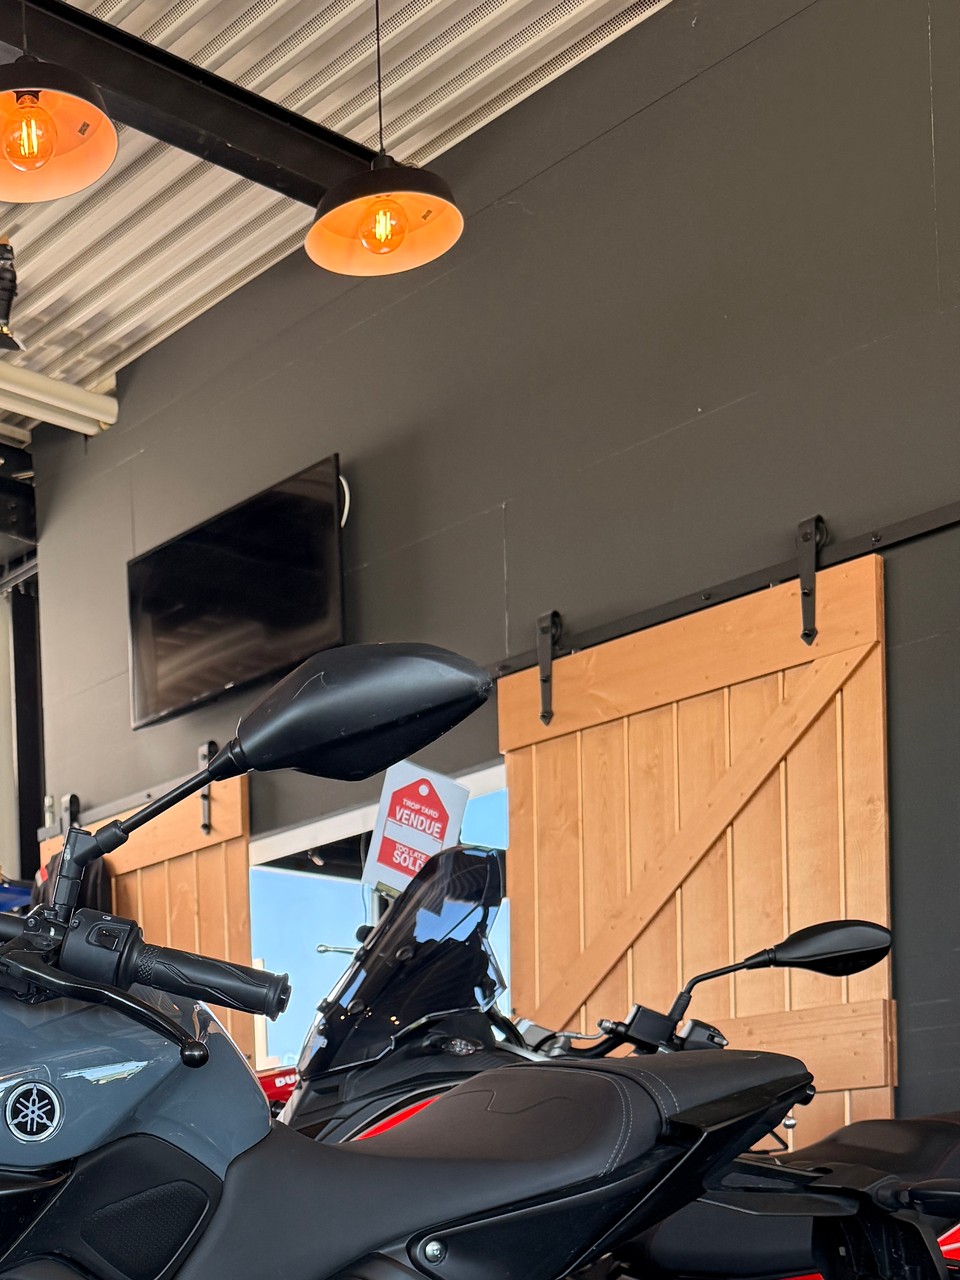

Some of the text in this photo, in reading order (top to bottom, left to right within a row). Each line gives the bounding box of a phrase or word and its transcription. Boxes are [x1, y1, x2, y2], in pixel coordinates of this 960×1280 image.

[402, 798, 439, 819] TROP TARD
[395, 806, 442, 838] VENDUE
[392, 850, 426, 872] SOLD
[395, 843, 426, 862] TOO LATE
